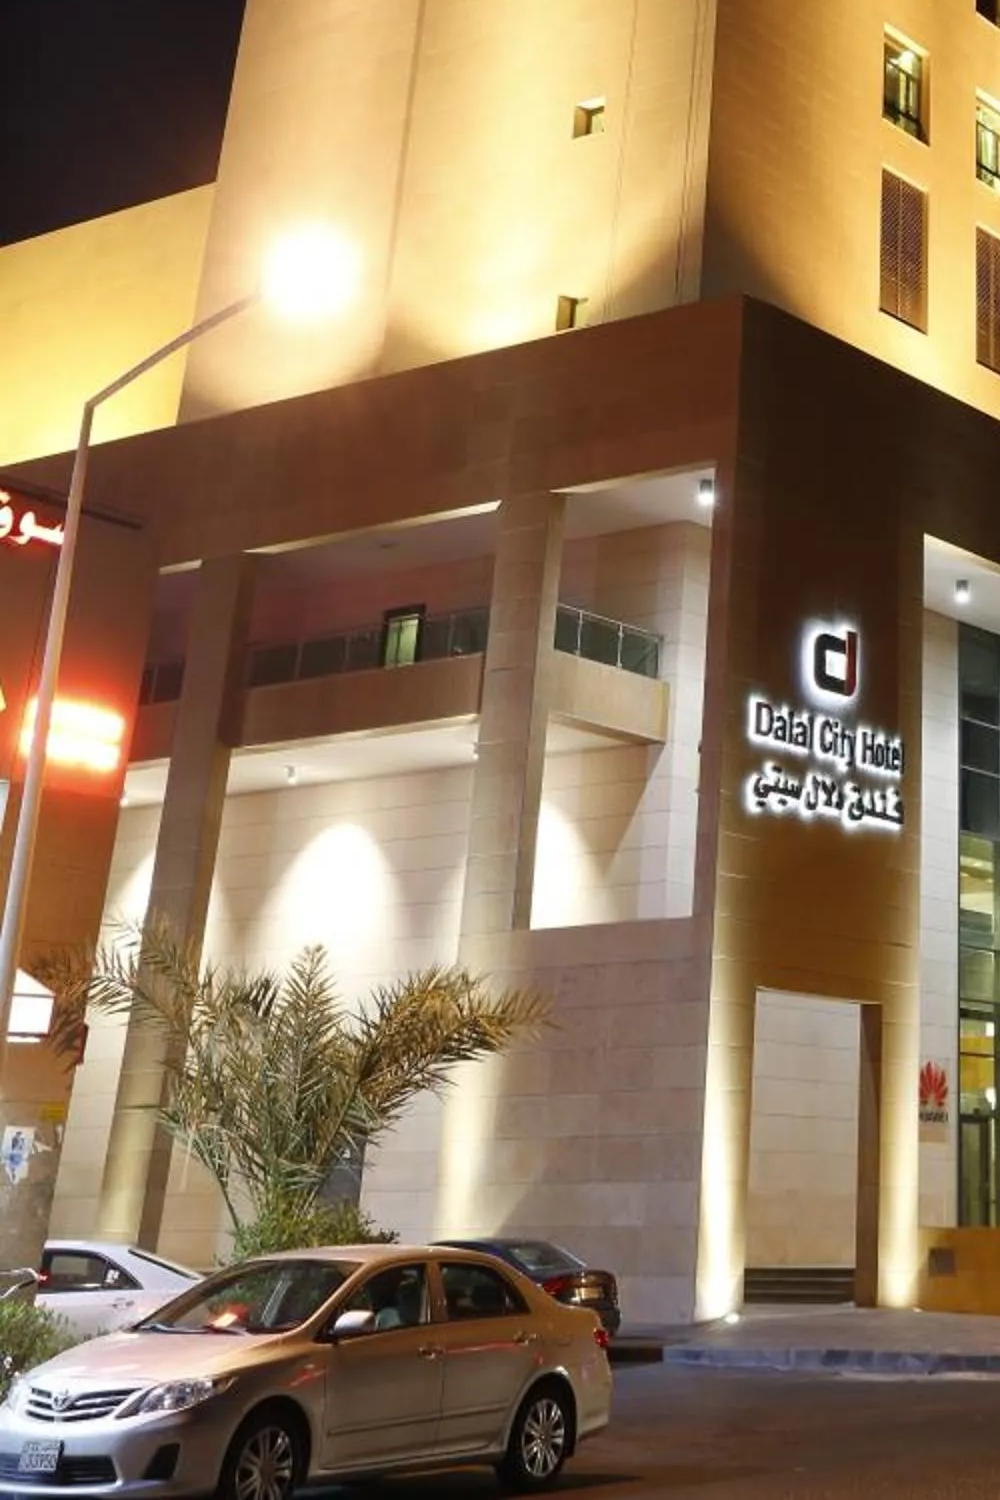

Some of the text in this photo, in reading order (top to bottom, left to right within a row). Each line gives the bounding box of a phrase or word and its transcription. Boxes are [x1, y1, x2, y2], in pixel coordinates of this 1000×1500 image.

[754, 701, 905, 775] Dalal City Hotel
[754, 764, 905, 825] فندق دلال سيتي
